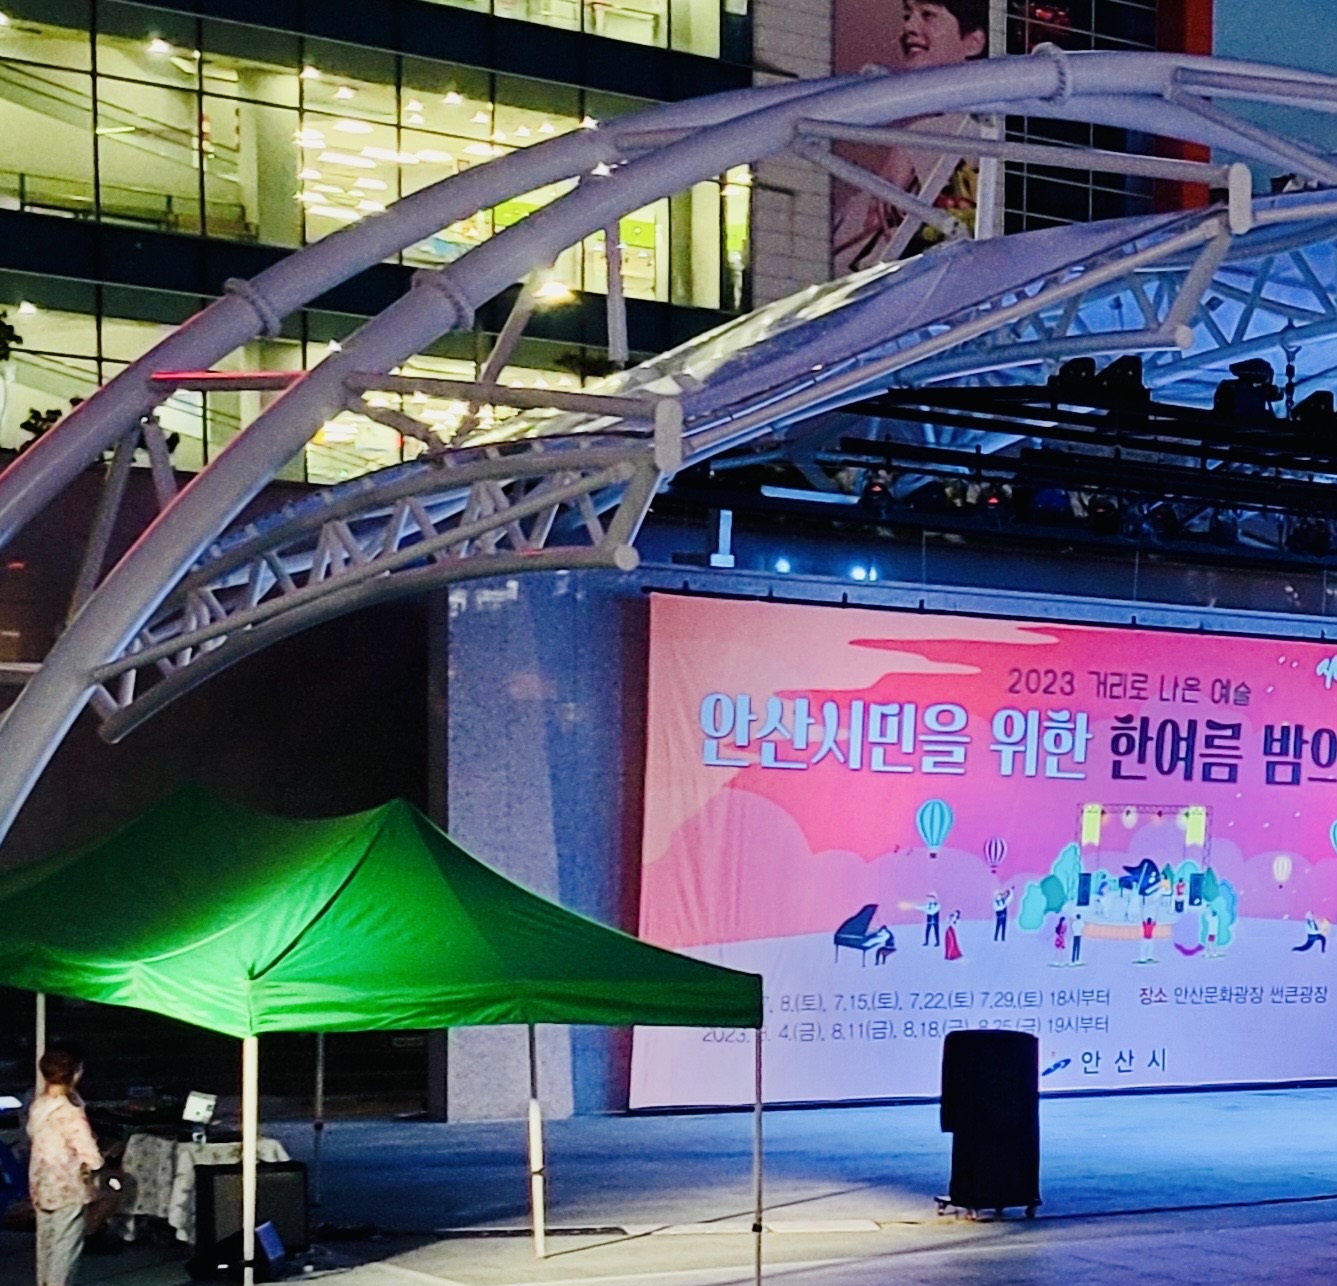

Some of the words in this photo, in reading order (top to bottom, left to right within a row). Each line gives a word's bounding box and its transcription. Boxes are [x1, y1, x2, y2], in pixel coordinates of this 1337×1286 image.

[1008, 667, 1076, 698] 2023
[1087, 669, 1148, 702] 거리로
[1159, 673, 1202, 705] 나은
[1211, 676, 1252, 708] 예술
[699, 689, 972, 777] 안산시민을
[989, 706, 1094, 783] 위한
[1109, 710, 1245, 785] 한여름
[1049, 987, 1110, 1006] 18시부터
[1139, 985, 1168, 1005] 장소
[1174, 984, 1264, 1004] 안산문화광장
[1269, 984, 1329, 1003] 썬큰광장
[1048, 1015, 1109, 1034] 19시부터
